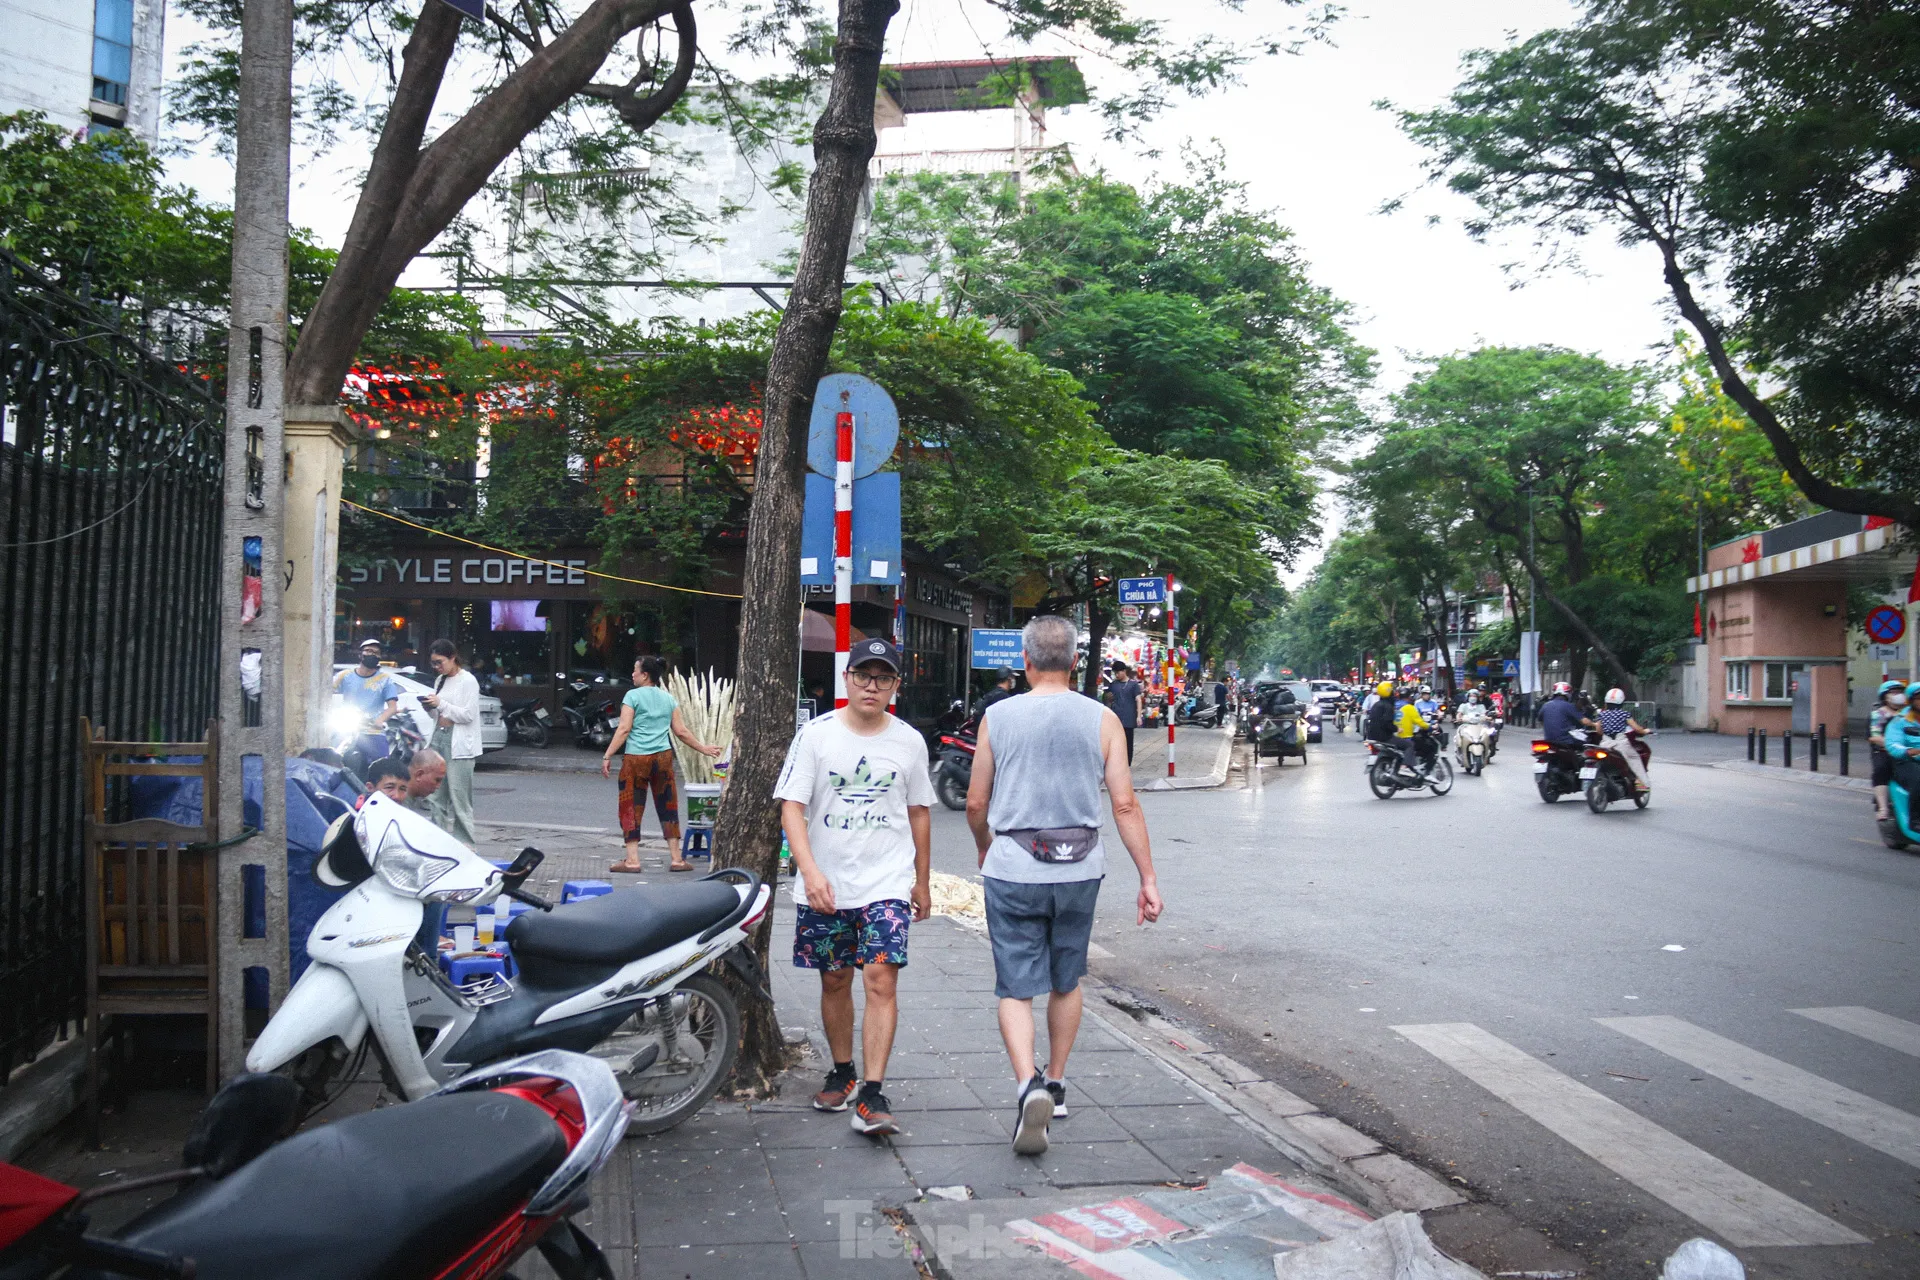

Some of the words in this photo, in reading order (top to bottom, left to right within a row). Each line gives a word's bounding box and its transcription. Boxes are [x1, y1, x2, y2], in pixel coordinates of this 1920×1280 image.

[350, 559, 452, 583] STYLE
[461, 559, 586, 585] COFFEE
[1138, 580, 1155, 588] PHỐ
